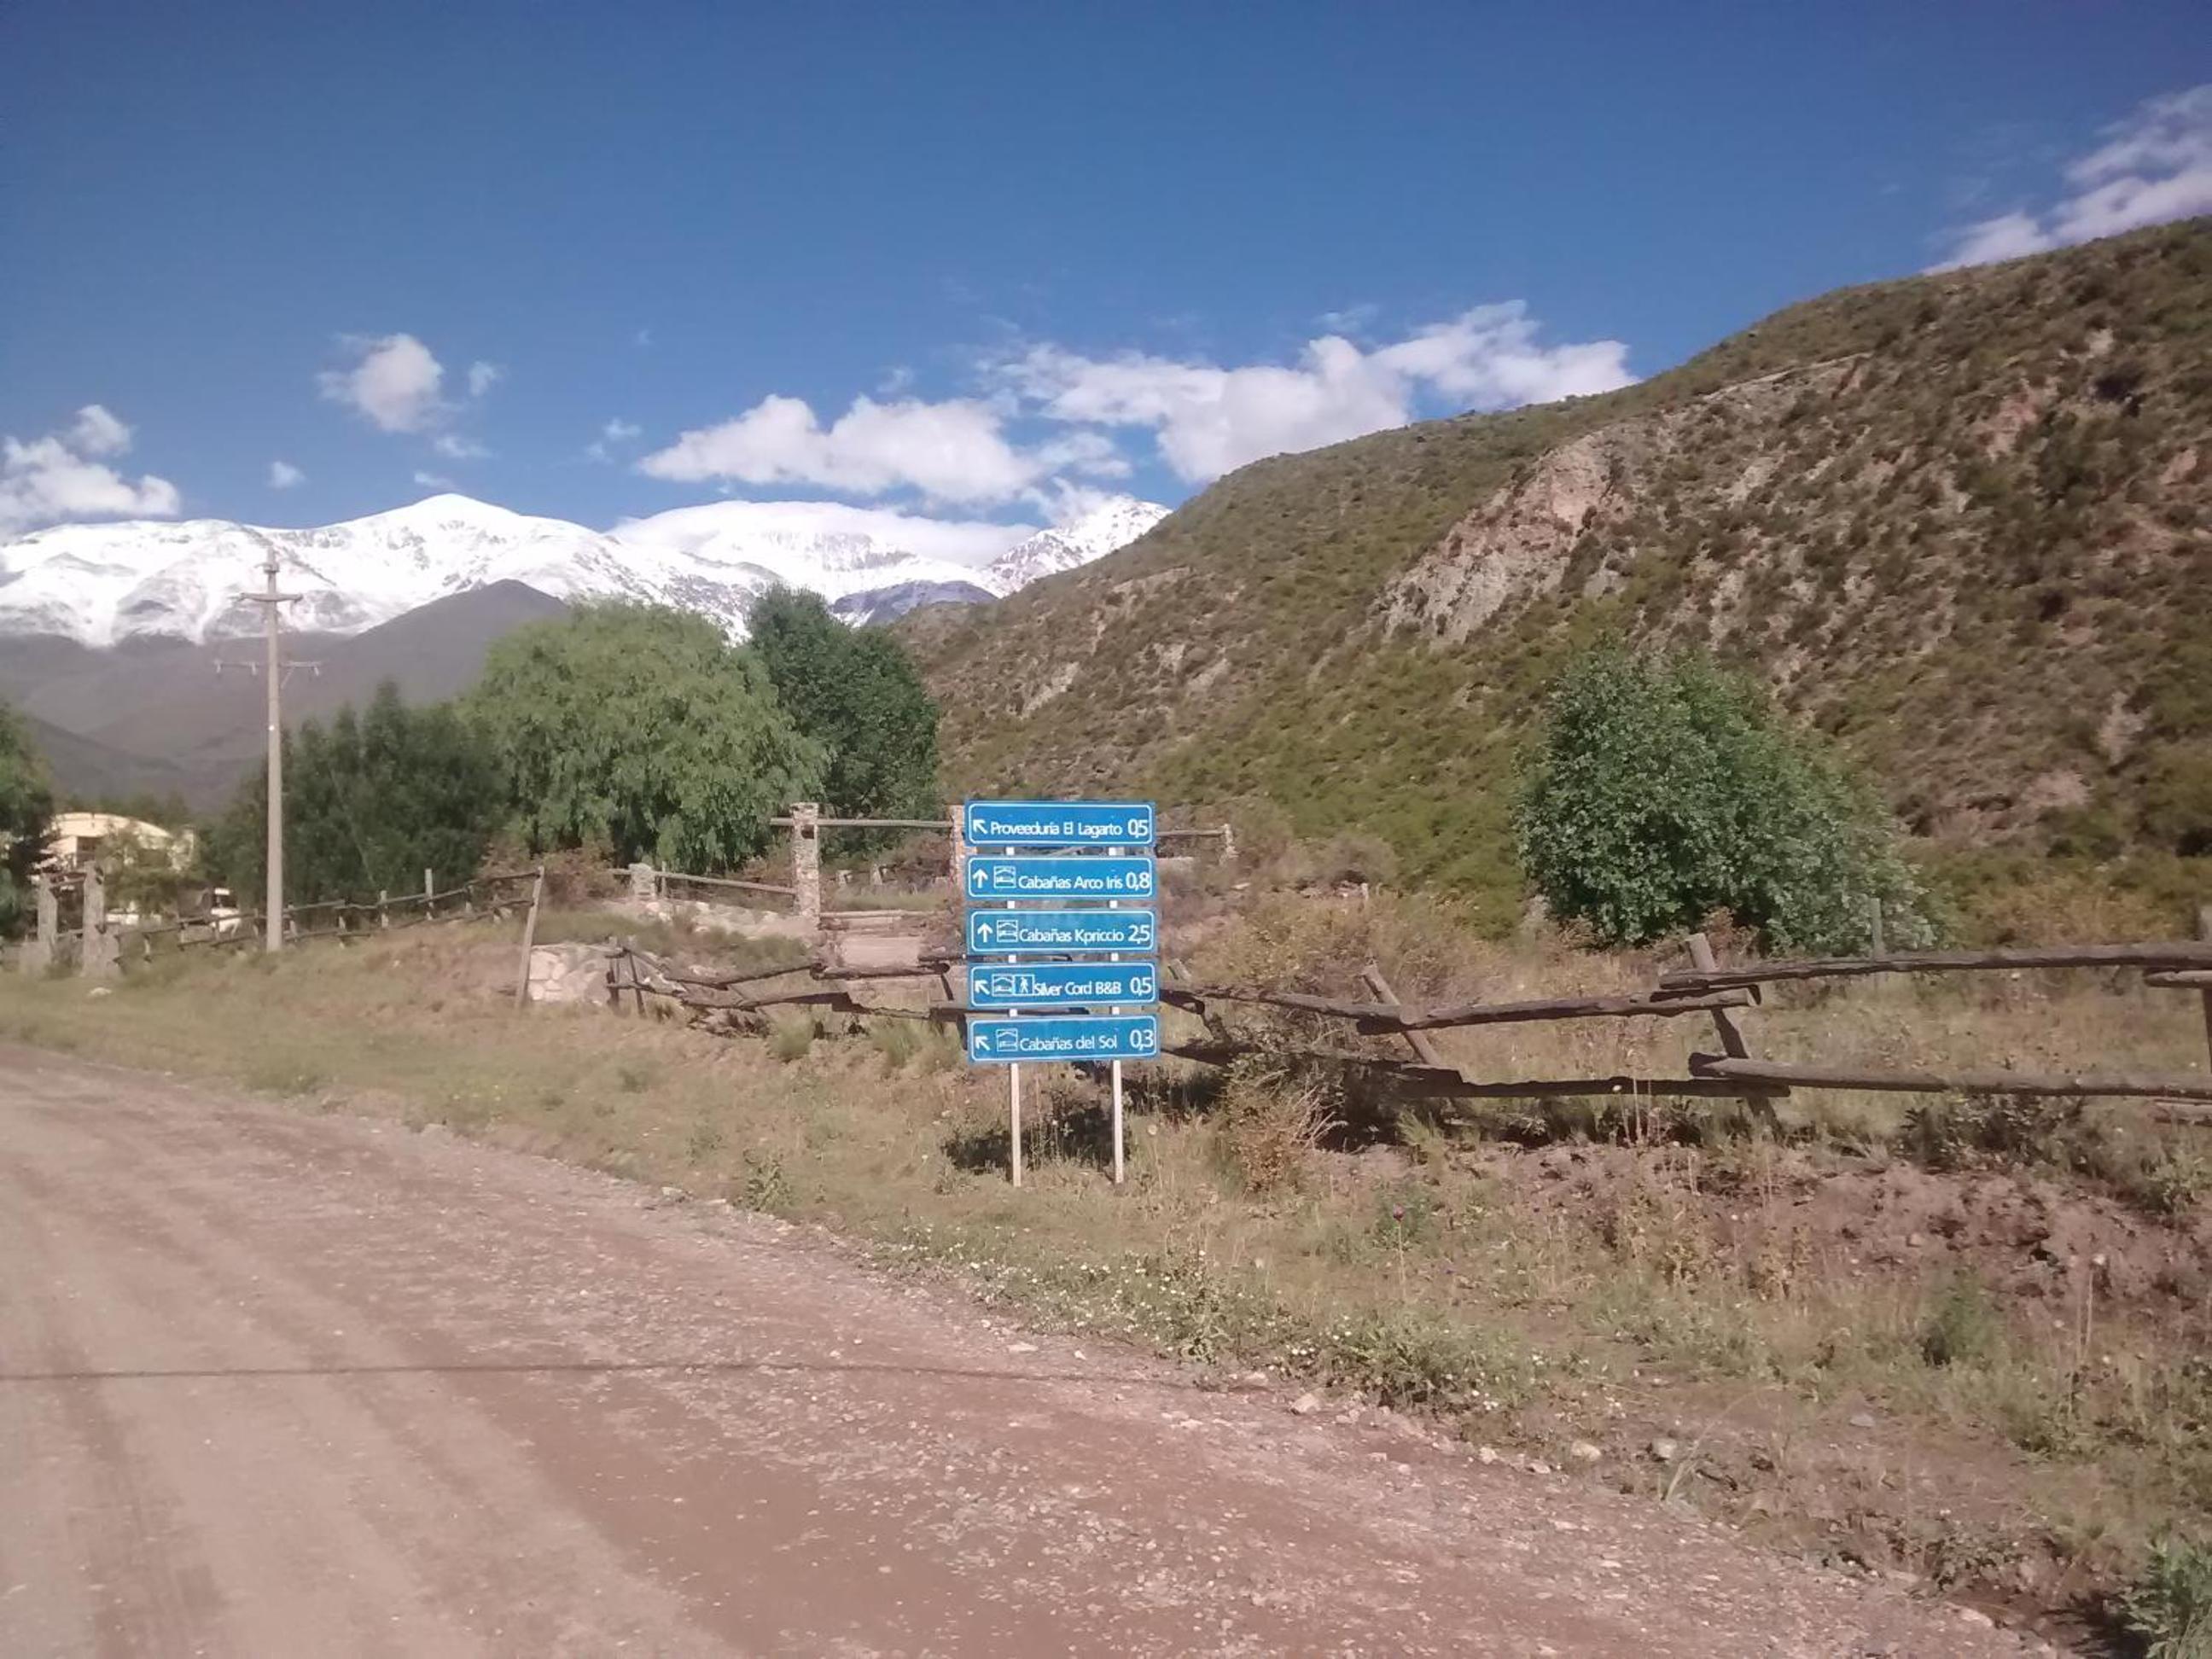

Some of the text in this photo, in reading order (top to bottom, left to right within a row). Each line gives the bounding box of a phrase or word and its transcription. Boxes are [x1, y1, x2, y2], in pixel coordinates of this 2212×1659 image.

[1064, 822, 1073, 834] El
[1079, 823, 1122, 838] Lagarto
[1019, 873, 1150, 890] Cabañas Arco Iris 0,8
[1020, 929, 1072, 942] Cabañas
[1075, 929, 1124, 945] Kpriccio
[1034, 983, 1062, 996] Silver
[1066, 981, 1091, 995] Cord
[1096, 982, 1121, 994] B&B
[1020, 1030, 1154, 1051] Cabañas del Sol 0,3
